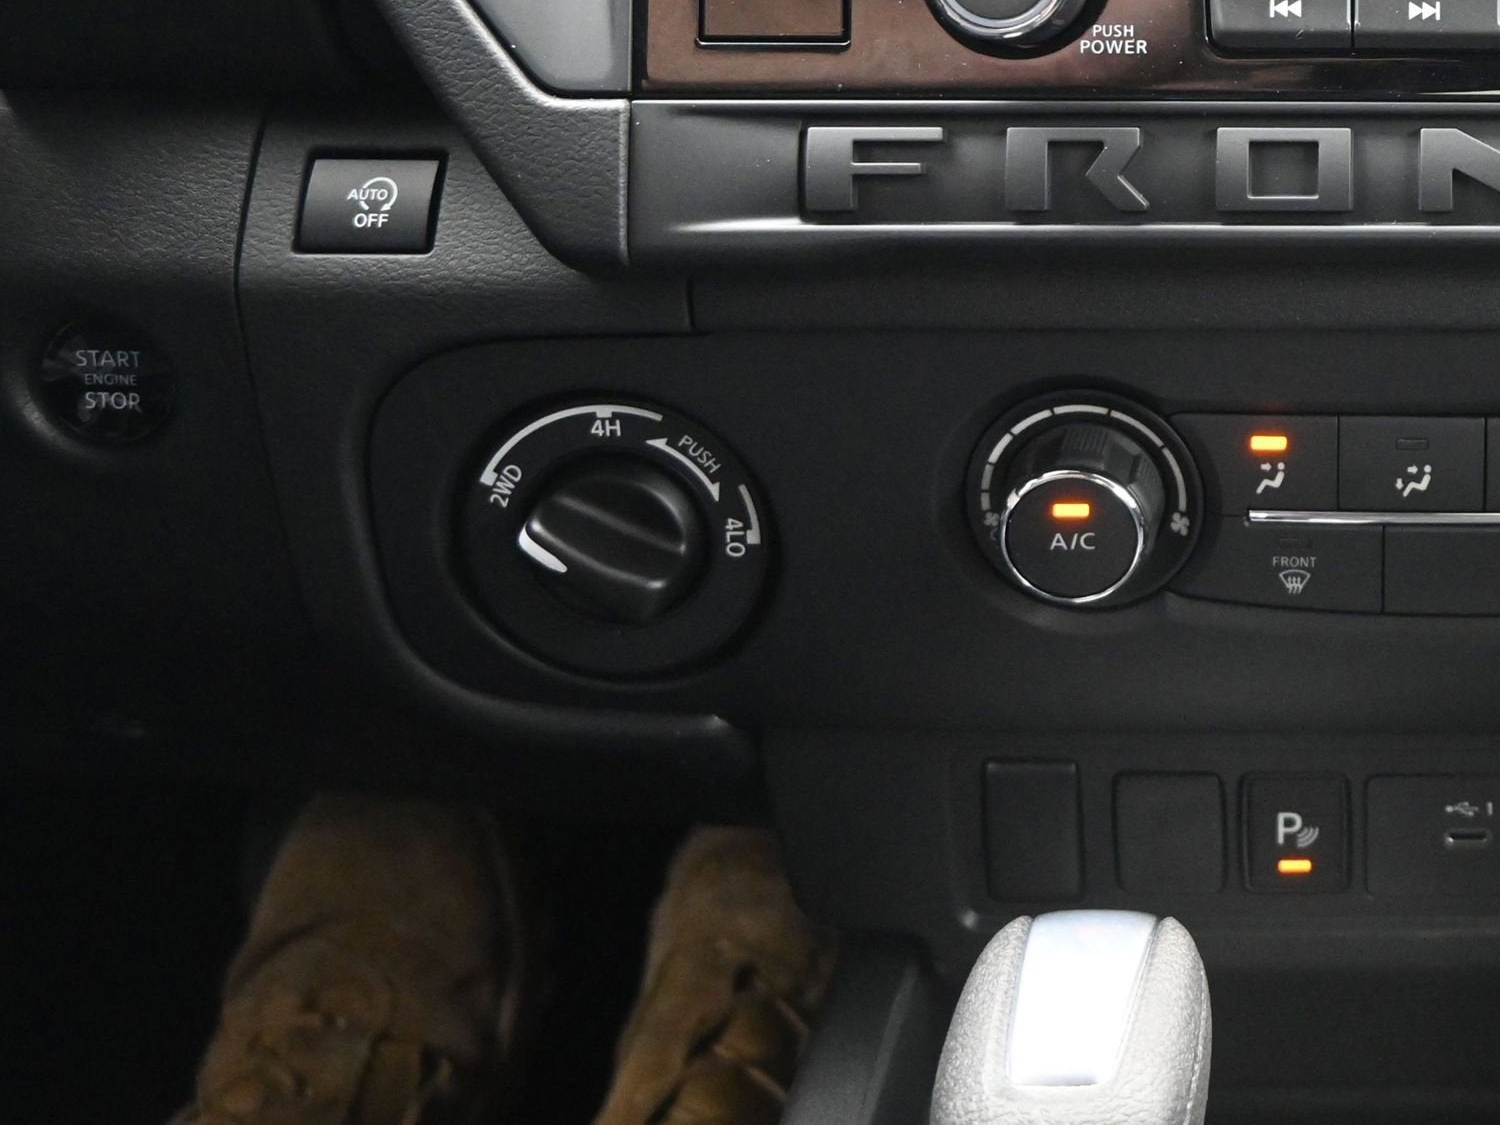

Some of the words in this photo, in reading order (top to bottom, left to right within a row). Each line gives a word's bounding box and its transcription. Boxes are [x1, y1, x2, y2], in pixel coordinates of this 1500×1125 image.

[1092, 24, 1134, 37] PUSH
[1080, 39, 1148, 55] POWER
[346, 188, 388, 201] AUTO
[354, 213, 389, 228] OFF
[75, 349, 141, 368] START
[84, 373, 138, 386] ENGINE
[84, 391, 142, 412] STOP
[590, 419, 621, 437] 4H
[678, 434, 721, 474] PUSH
[489, 463, 522, 508] 2WD
[725, 517, 746, 557] 4LO
[1050, 532, 1096, 550] A/C
[1272, 556, 1317, 568] FRONT
[1486, 801, 1494, 816] 1
[1277, 812, 1302, 846] P
